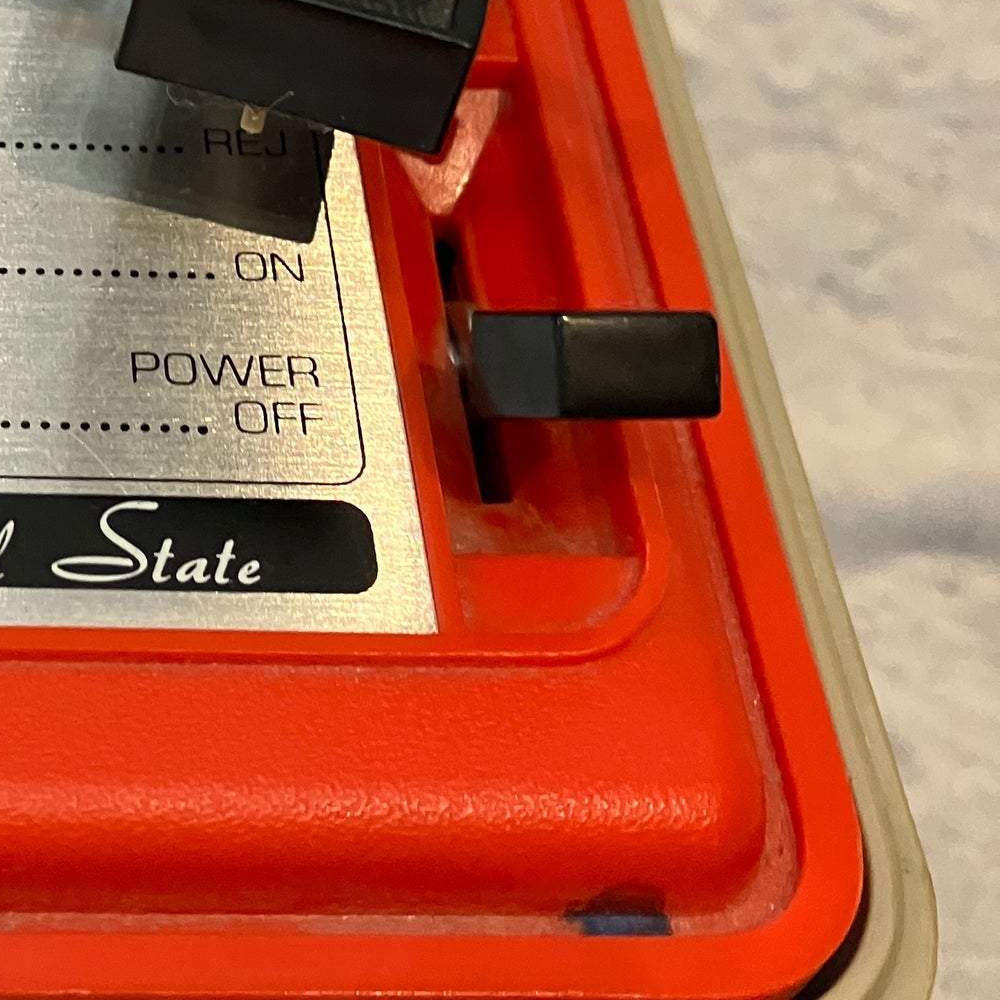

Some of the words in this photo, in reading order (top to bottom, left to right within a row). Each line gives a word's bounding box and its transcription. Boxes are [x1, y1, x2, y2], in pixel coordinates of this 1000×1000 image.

[203, 127, 287, 156] REJ
[234, 251, 305, 282] ON
[130, 351, 320, 388] POWER
[234, 400, 323, 435] OFF
[51, 500, 262, 586] State
